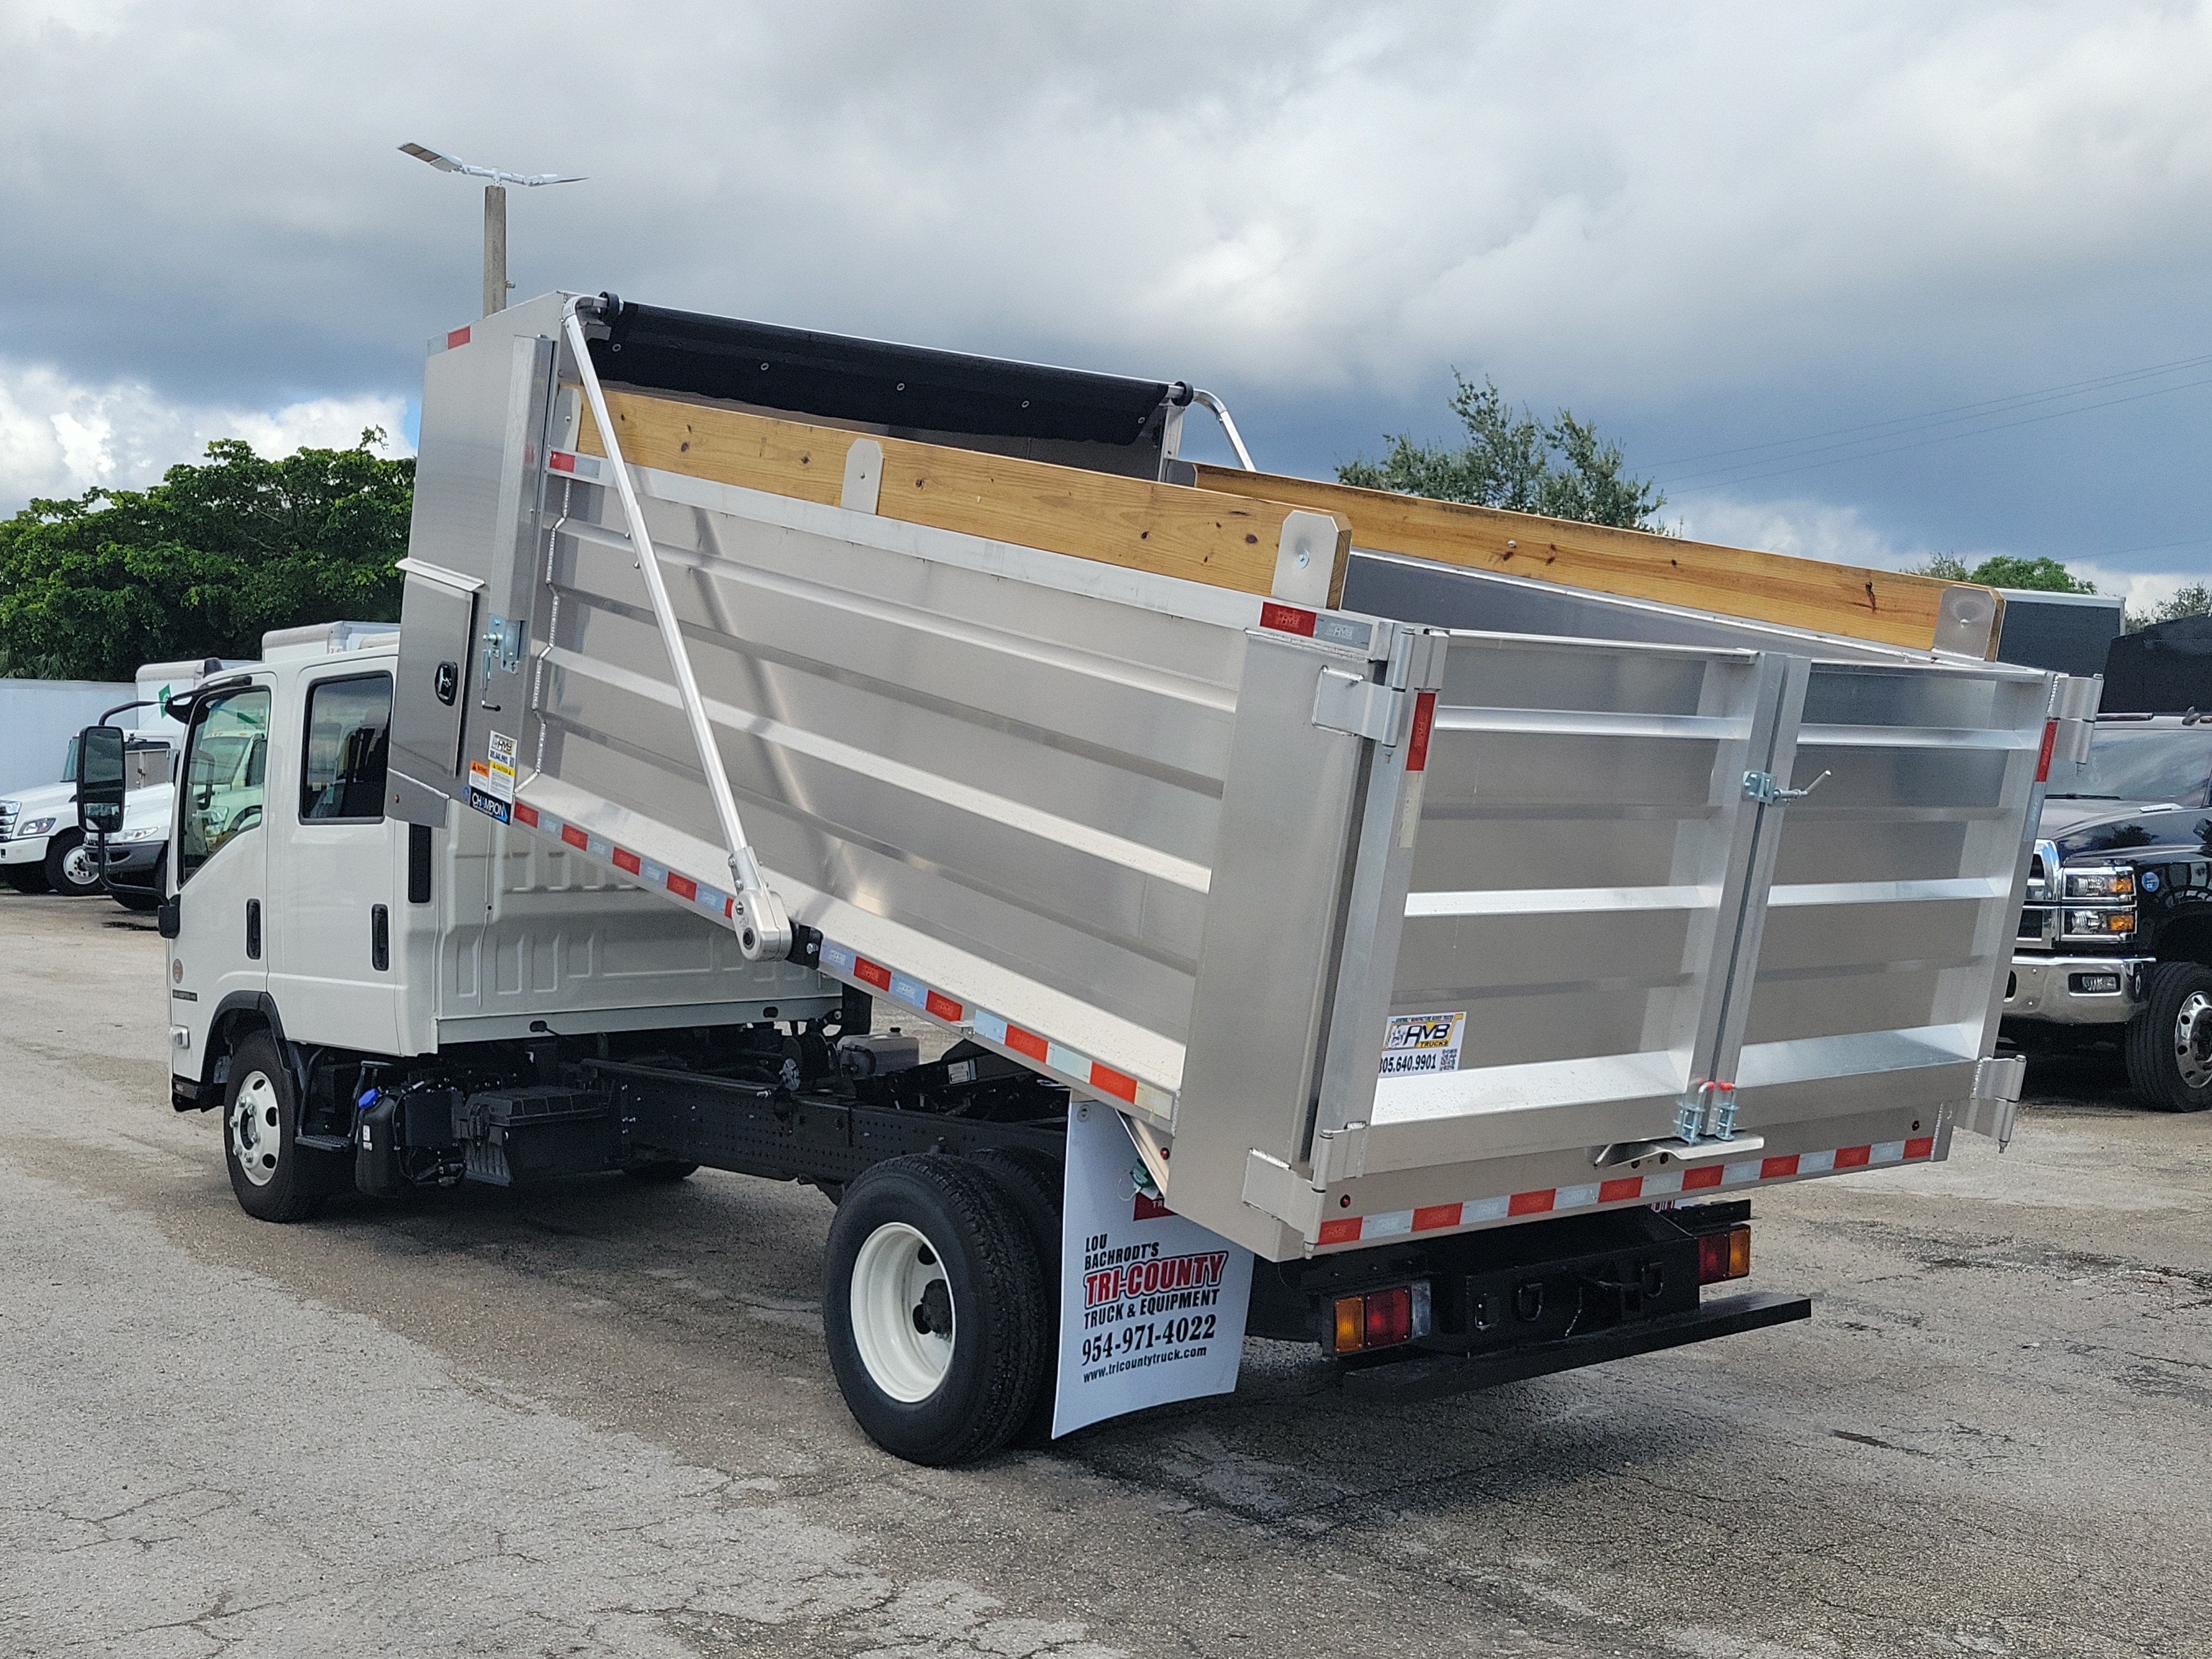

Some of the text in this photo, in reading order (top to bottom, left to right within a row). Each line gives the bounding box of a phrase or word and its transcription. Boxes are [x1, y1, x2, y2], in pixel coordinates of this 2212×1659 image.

[1084, 1242, 1159, 1271] BACHRODT'S
[1085, 1233, 1108, 1252] LOU
[1085, 1252, 1226, 1307] TRI-COUNTY
[1084, 1289, 1220, 1330] TRUCK & EQUIPMENT
[1081, 1314, 1217, 1367] 954-971-4022
[1083, 1346, 1207, 1383] www.tricountytruck.com
